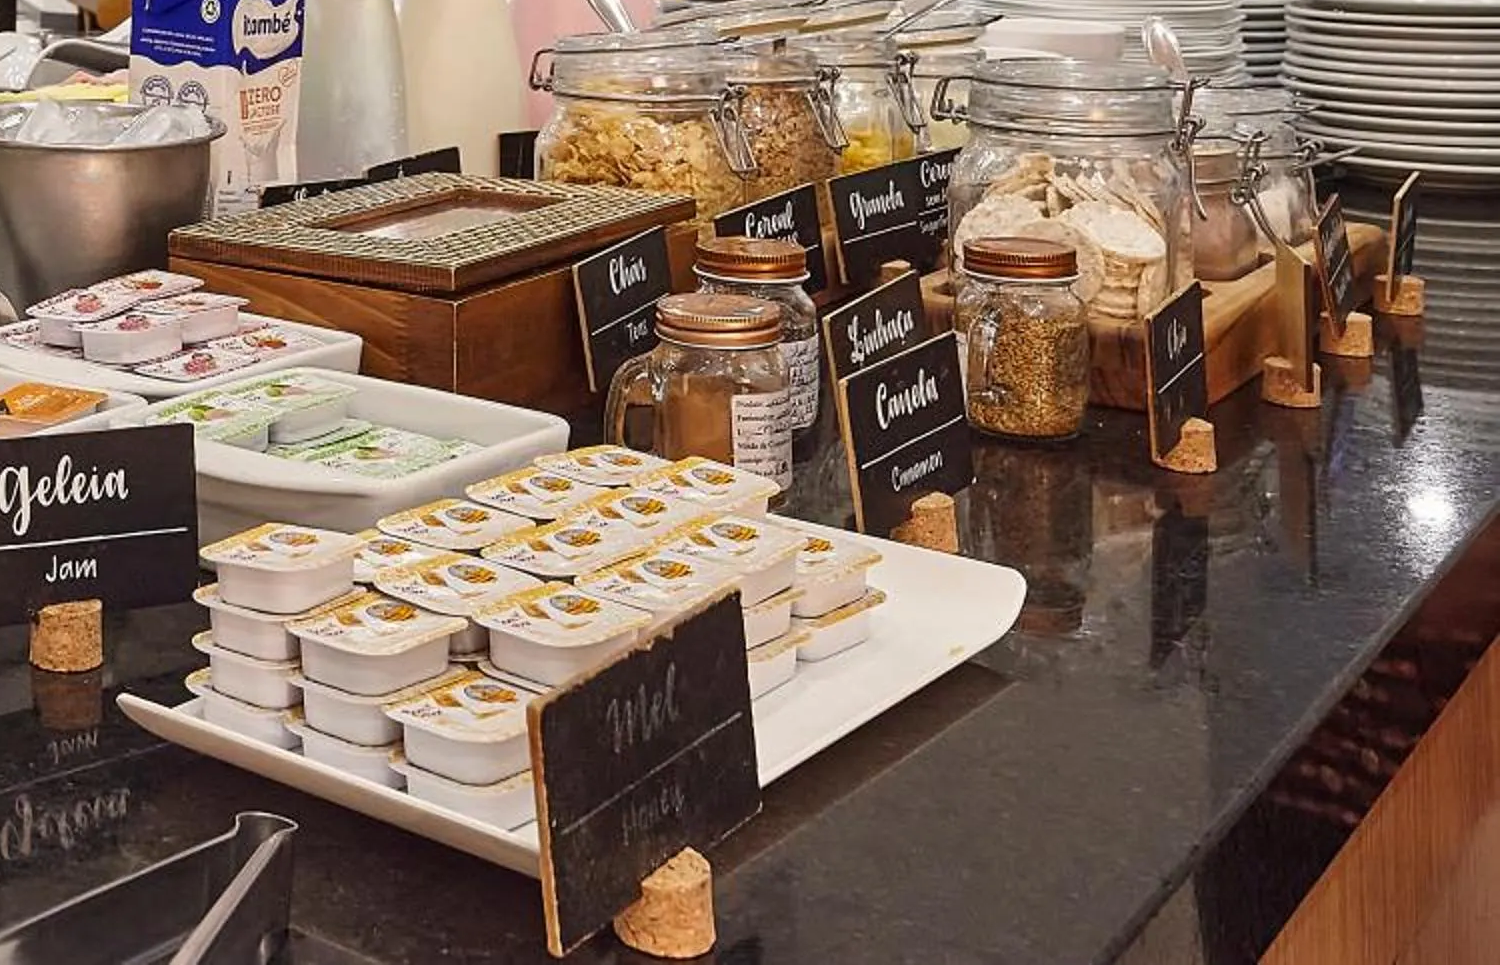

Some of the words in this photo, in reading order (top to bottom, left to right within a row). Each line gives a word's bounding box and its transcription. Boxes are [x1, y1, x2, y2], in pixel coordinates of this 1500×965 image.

[243, 10, 291, 36] itambé
[247, 86, 283, 103] ZERO
[875, 367, 939, 431] Canela
[45, 554, 97, 583] Jam
